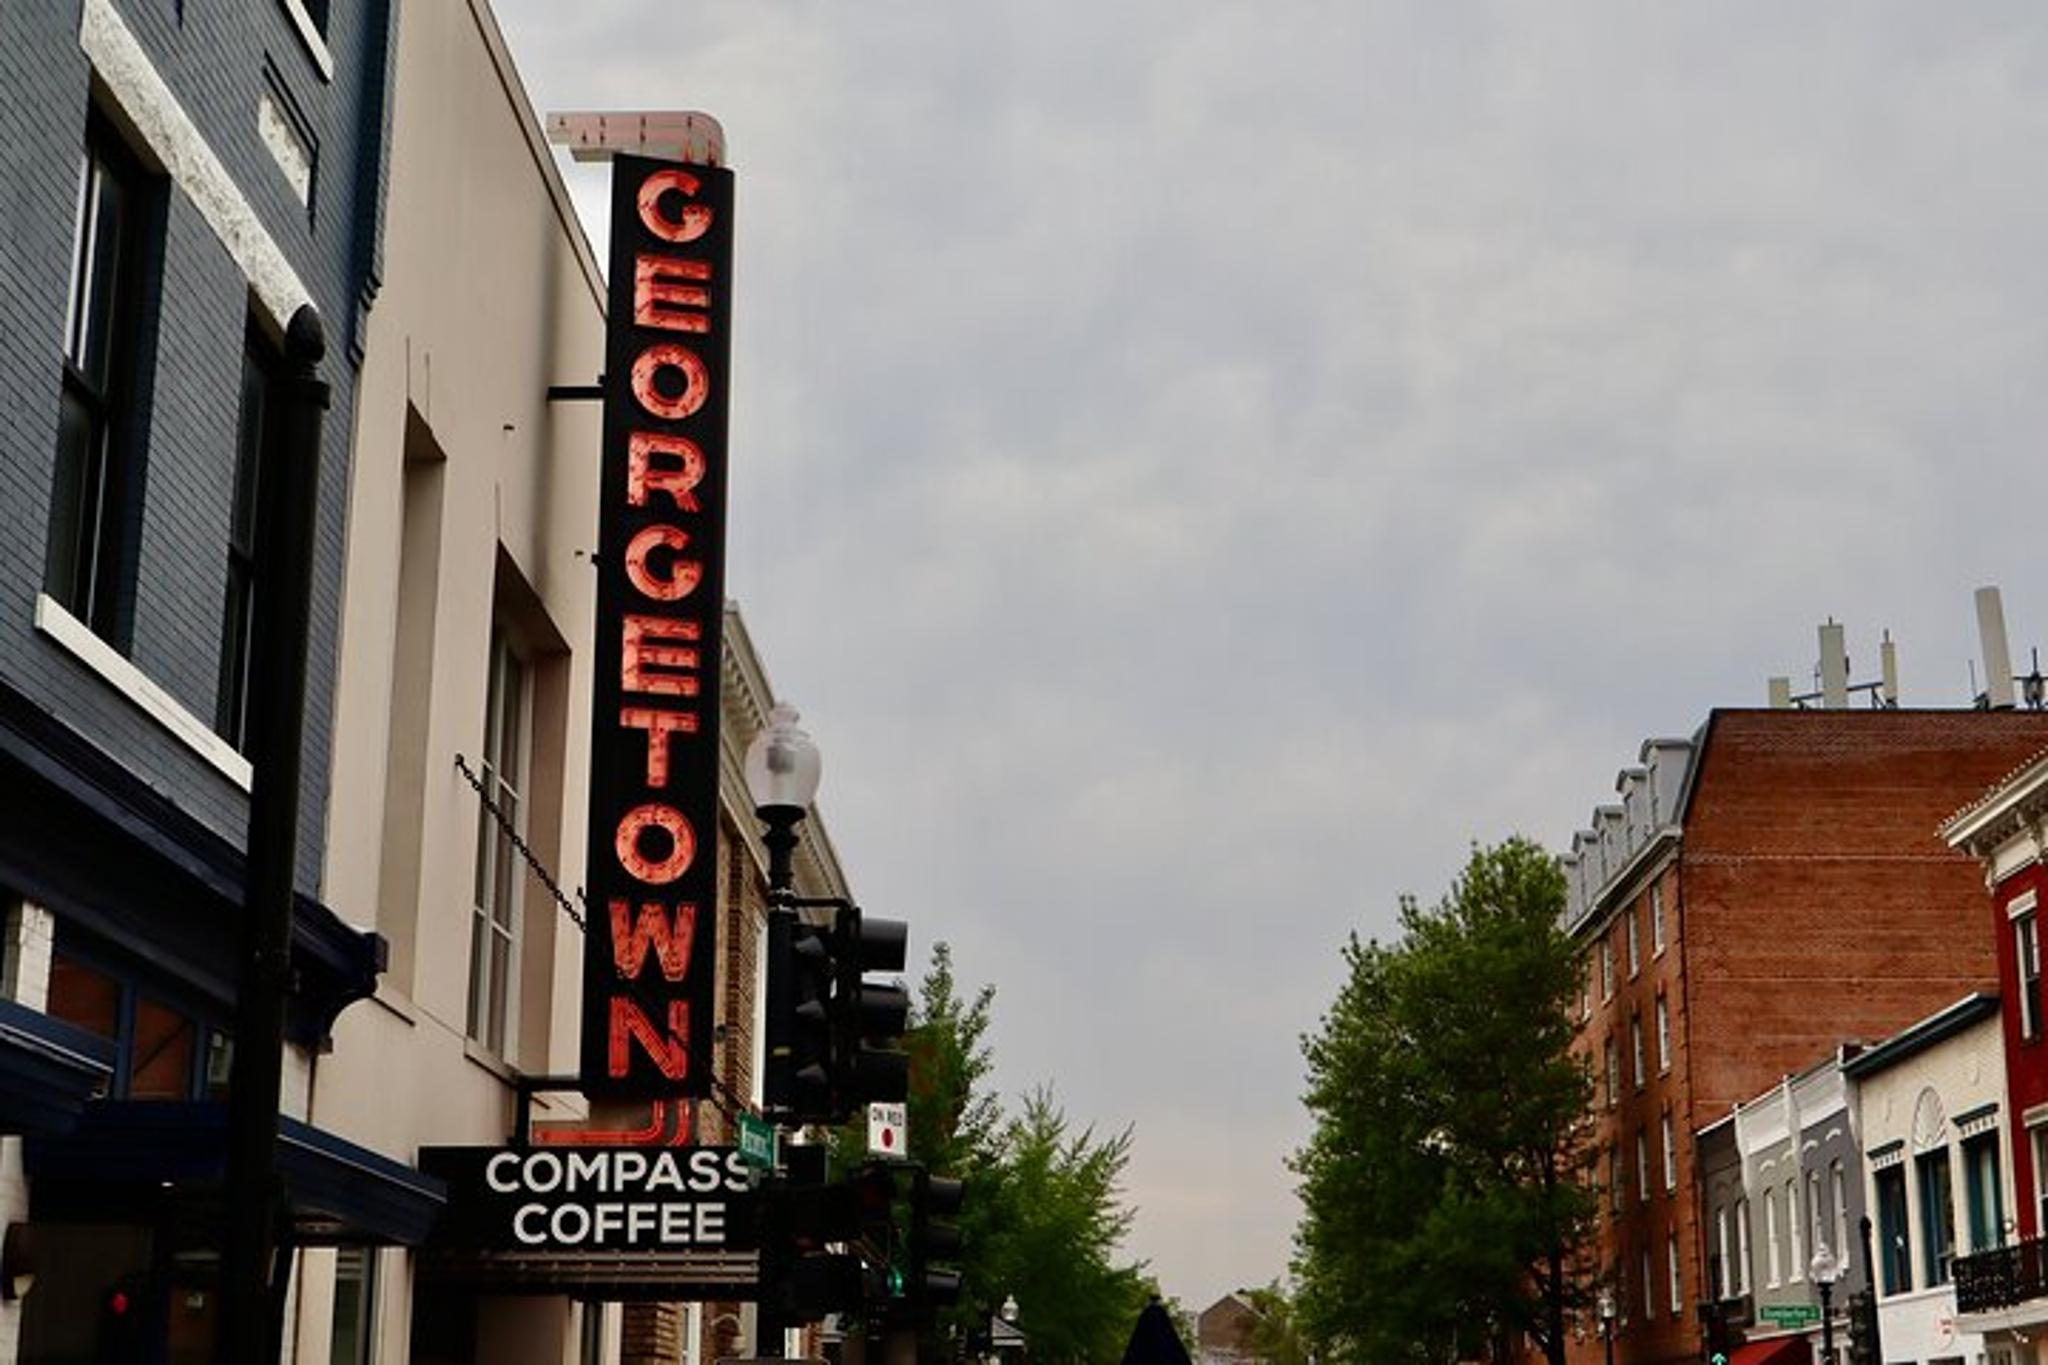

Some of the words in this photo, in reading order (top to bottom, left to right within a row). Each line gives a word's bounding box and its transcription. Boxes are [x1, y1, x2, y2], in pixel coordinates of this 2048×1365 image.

[608, 168, 714, 1079] GEORGETOWN
[486, 1150, 749, 1193] COMPASS
[514, 1203, 726, 1244] COFFEE
